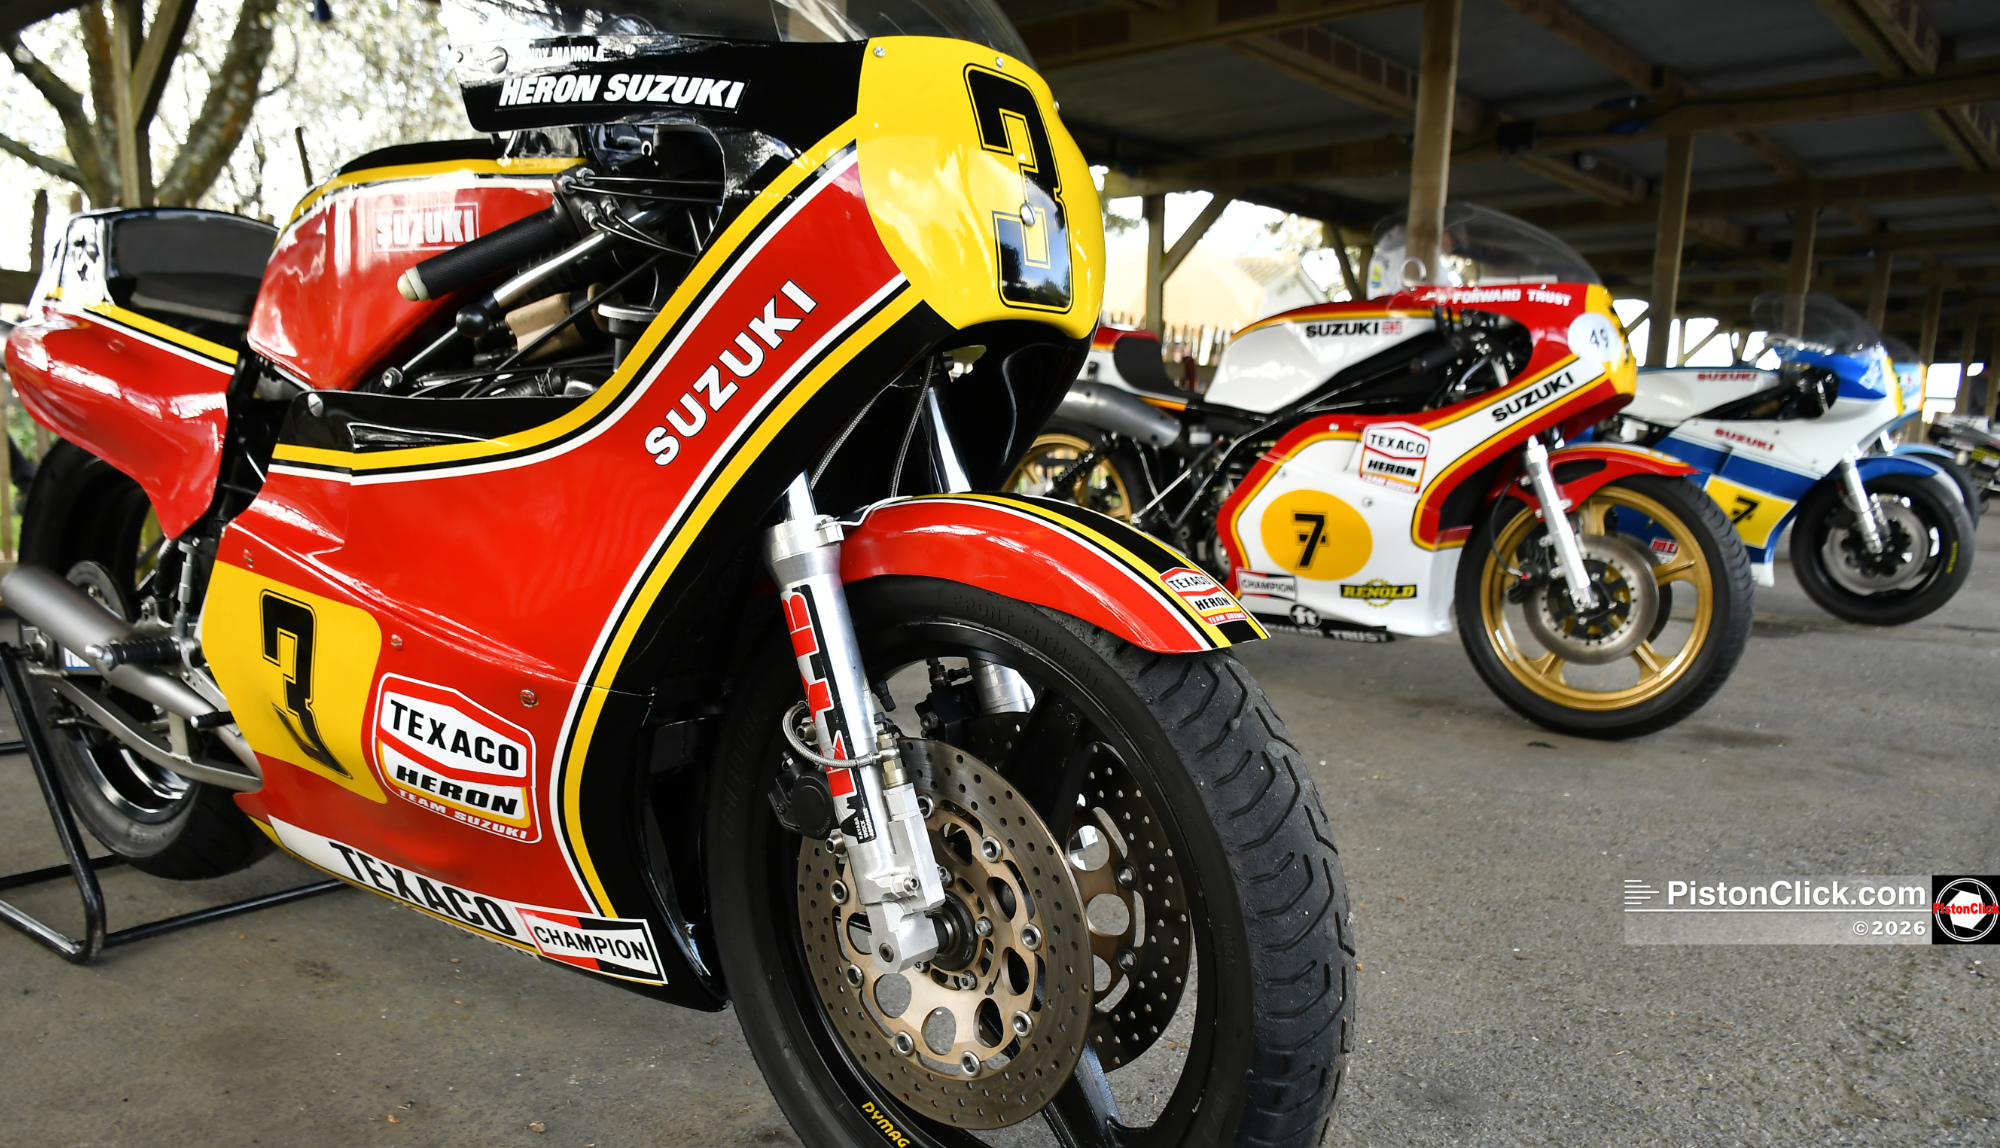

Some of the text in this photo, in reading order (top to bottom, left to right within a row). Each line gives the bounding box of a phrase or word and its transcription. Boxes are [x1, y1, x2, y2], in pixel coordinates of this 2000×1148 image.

[499, 74, 745, 108] HERON SUZUKI
[963, 62, 1075, 314] 3
[376, 209, 475, 246] SUZUKI
[1452, 288, 1571, 306] FORWARD TRUST
[1305, 321, 1379, 338] SUZUKI
[645, 278, 818, 466] SUZUKI
[1492, 371, 1574, 422] SUZUKI
[1370, 433, 1425, 454] TEXACO
[1715, 428, 1774, 451] SUZUKI
[1291, 510, 1329, 570] 7
[1168, 575, 1212, 590] TEXACO
[1242, 578, 1295, 594] CHAMPION
[1343, 584, 1416, 598] RENOLD
[1194, 597, 1231, 610] HERON
[1207, 614, 1226, 624] TEAM
[390, 699, 519, 771] TEXACO
[396, 764, 518, 815] HERON
[398, 788, 527, 839] TEAM SUZUKI
[329, 842, 517, 936] TEXACO
[533, 925, 649, 961] CHAMPION
[861, 1101, 911, 1148] DYMAG
